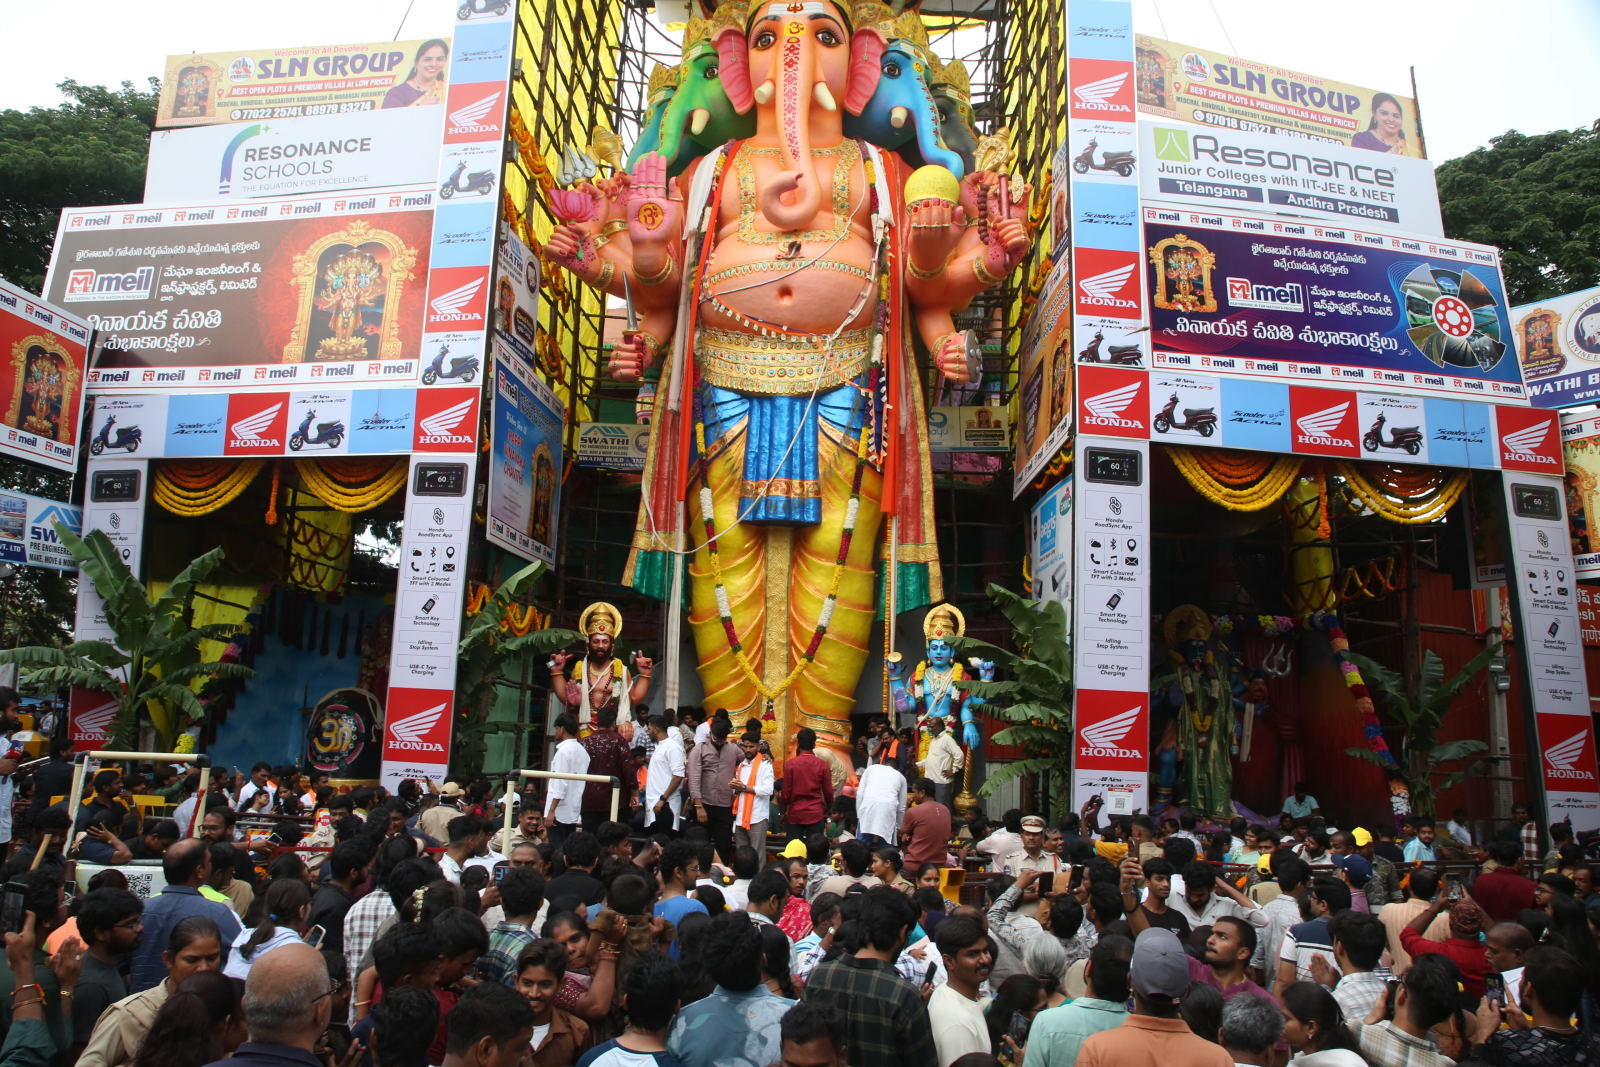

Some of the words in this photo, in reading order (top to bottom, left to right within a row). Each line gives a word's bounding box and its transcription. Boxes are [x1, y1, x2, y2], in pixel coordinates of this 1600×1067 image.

[258, 57, 308, 79] SLN
[314, 52, 403, 77] GROUP
[1228, 57, 1264, 71] Welcome
[1276, 67, 1286, 77] All
[250, 86, 265, 94] OPEN
[294, 82, 322, 91] PREMIUM
[1213, 63, 1266, 94] SLN
[1272, 78, 1360, 115] GROUP
[242, 108, 271, 119] 77022
[306, 104, 337, 115] 88979
[340, 101, 371, 113] 93274
[1074, 102, 1131, 112] HONDA
[1190, 86, 1207, 96] BEST
[1209, 89, 1226, 100] OPEN
[1228, 93, 1248, 104] PLOTS
[1256, 99, 1285, 114] PREMIUM
[1287, 106, 1309, 119] VILLAS
[1319, 114, 1331, 123] LOW
[1333, 117, 1356, 129] PRICES
[1206, 113, 1238, 128] 97018
[448, 125, 499, 134] HONDA
[244, 137, 372, 162] RESONANCE
[1193, 134, 1394, 188] Resonance
[243, 160, 332, 182] SCHOOLS
[243, 184, 259, 192] THE
[262, 180, 299, 191] EQUATION
[301, 179, 316, 188] FOR
[318, 176, 368, 186] EXCELLENCE
[1158, 162, 1201, 177] Junior
[1206, 167, 1266, 184] Colleges
[1271, 174, 1298, 188] with
[1302, 179, 1346, 194] IIT-JEE
[1350, 186, 1358, 196] &
[1362, 189, 1395, 202] NEET
[1176, 180, 1247, 199] Telangana
[85, 216, 110, 226] meil
[136, 213, 162, 223] meil
[188, 210, 214, 220] meil
[241, 207, 268, 218] meil
[295, 202, 321, 214] meil
[349, 198, 375, 210] meil
[404, 194, 431, 206] meil
[1288, 194, 1334, 211] Andhra
[1337, 202, 1388, 219] Pradesh
[1202, 217, 1222, 226] meil
[1244, 221, 1264, 230] meil
[1285, 225, 1304, 234] meil
[1325, 230, 1345, 239] meil
[1364, 235, 1383, 244] meil
[1402, 241, 1420, 250] meil
[1439, 247, 1456, 256] meil
[1475, 253, 1492, 262] meil
[252, 263, 261, 272] &
[99, 269, 153, 292] meil
[1080, 296, 1138, 308] HONDA
[1255, 283, 1301, 304] meil
[1383, 295, 1391, 303] &
[35, 307, 53, 324] meil
[69, 326, 86, 339] meil
[172, 309, 222, 330] చవితి
[430, 313, 482, 322] HONDA
[104, 333, 195, 352] శుభాకాంక్షలు
[1177, 317, 1248, 337] వినాయక
[1252, 322, 1294, 342] చవితి
[1299, 326, 1398, 355] శుభాకాంక్షలు
[102, 371, 129, 382] meil
[158, 370, 185, 381] meil
[213, 369, 241, 380] meil
[269, 366, 297, 378] meil
[326, 364, 354, 376] meil
[384, 362, 412, 374] meil
[1169, 355, 1190, 364] meil
[1213, 359, 1234, 368] meil
[1257, 362, 1278, 372] meil
[1300, 366, 1321, 375] meil
[1343, 369, 1364, 378] meil
[1385, 373, 1404, 382] meil
[1425, 376, 1444, 386] meil
[1464, 380, 1483, 390] meil
[1503, 384, 1521, 394] meil
[1084, 416, 1144, 429] HONDA
[1229, 417, 1282, 426] ACTIVA
[1232, 410, 1266, 418] Scooter
[419, 435, 473, 444] HONDA
[1433, 428, 1468, 436] Scooter
[18, 434, 37, 447] meil
[54, 444, 71, 457] meil
[230, 439, 280, 448] HONDA
[580, 437, 629, 445] SWATHI
[1298, 435, 1354, 447] HONDA
[1504, 452, 1557, 464] HONDA
[30, 542, 40, 551] PRE
[389, 741, 444, 752] HONDA
[1080, 748, 1142, 758] HONDA
[1548, 769, 1594, 779] HONDA
